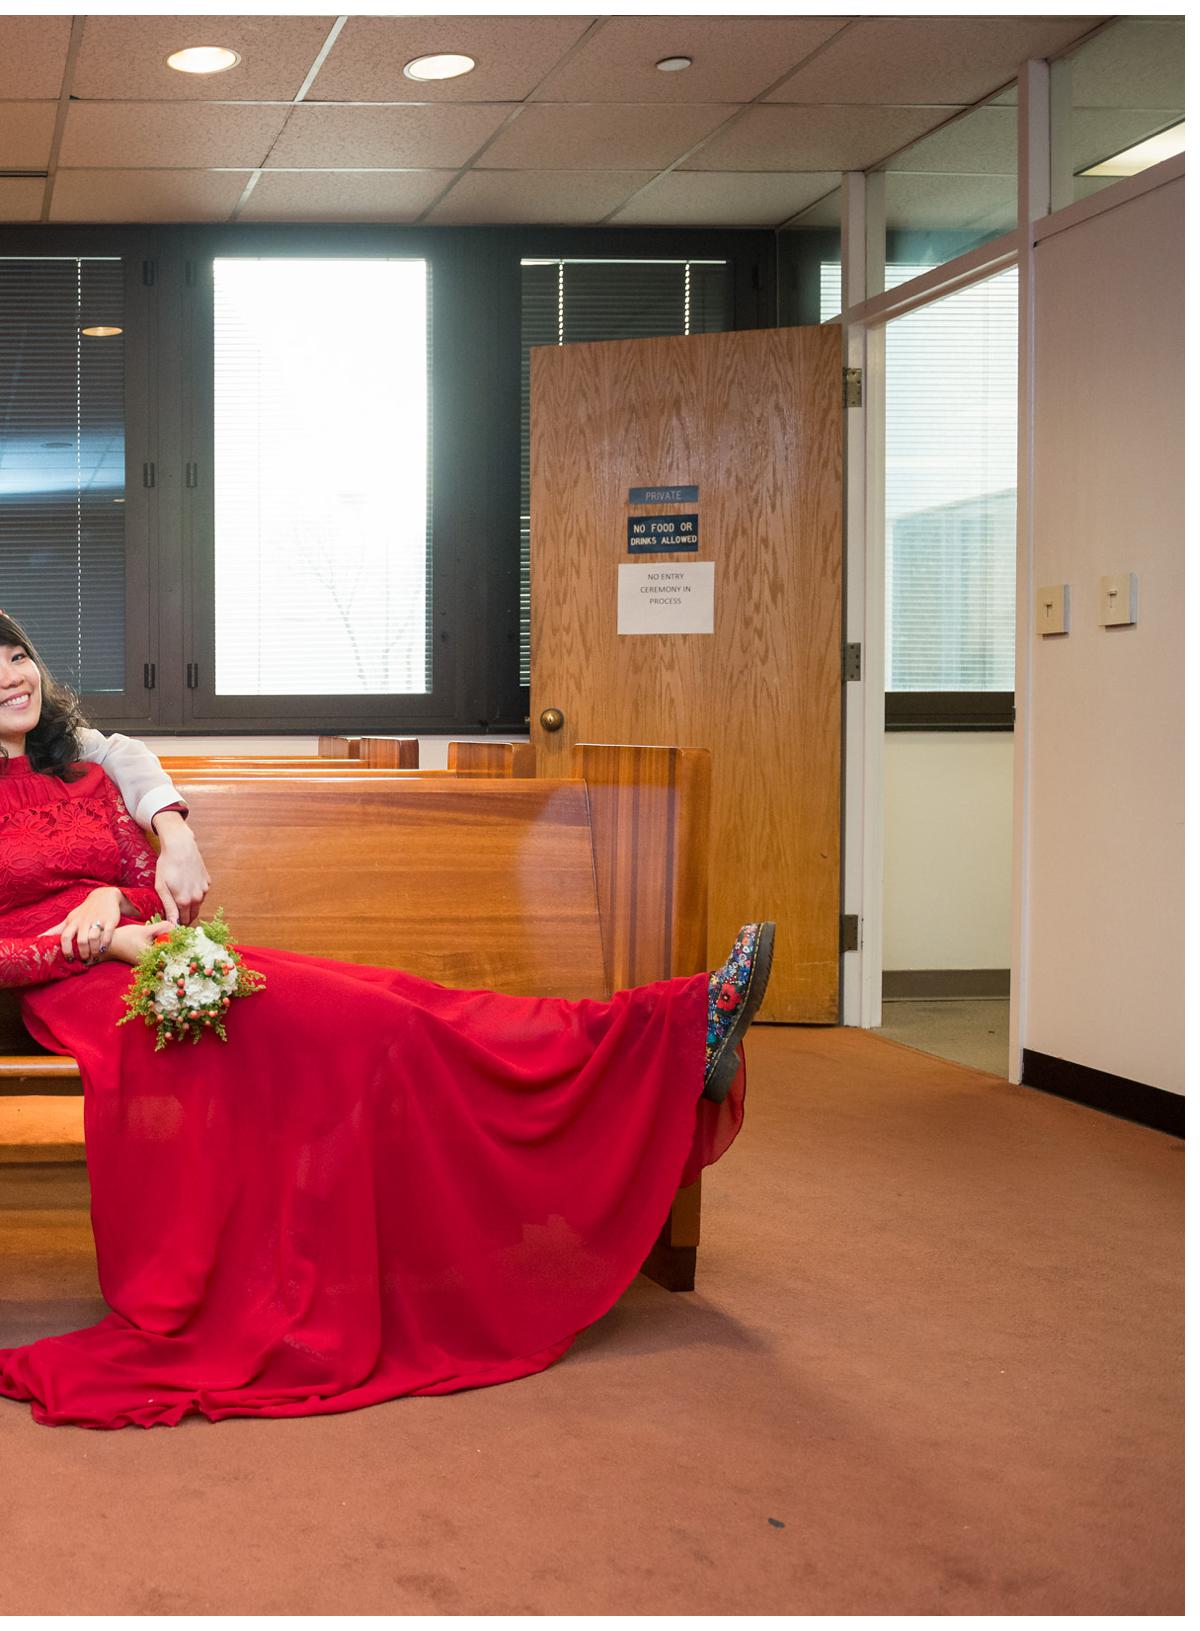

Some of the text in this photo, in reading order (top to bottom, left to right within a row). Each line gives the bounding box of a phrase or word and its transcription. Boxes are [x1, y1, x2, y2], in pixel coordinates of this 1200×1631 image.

[645, 490, 682, 501] PRIVATE
[633, 521, 693, 533] NO FOOD OR
[630, 535, 697, 546] DRINKS ALLOWED
[647, 573, 660, 581] NO
[682, 585, 691, 593] IN
